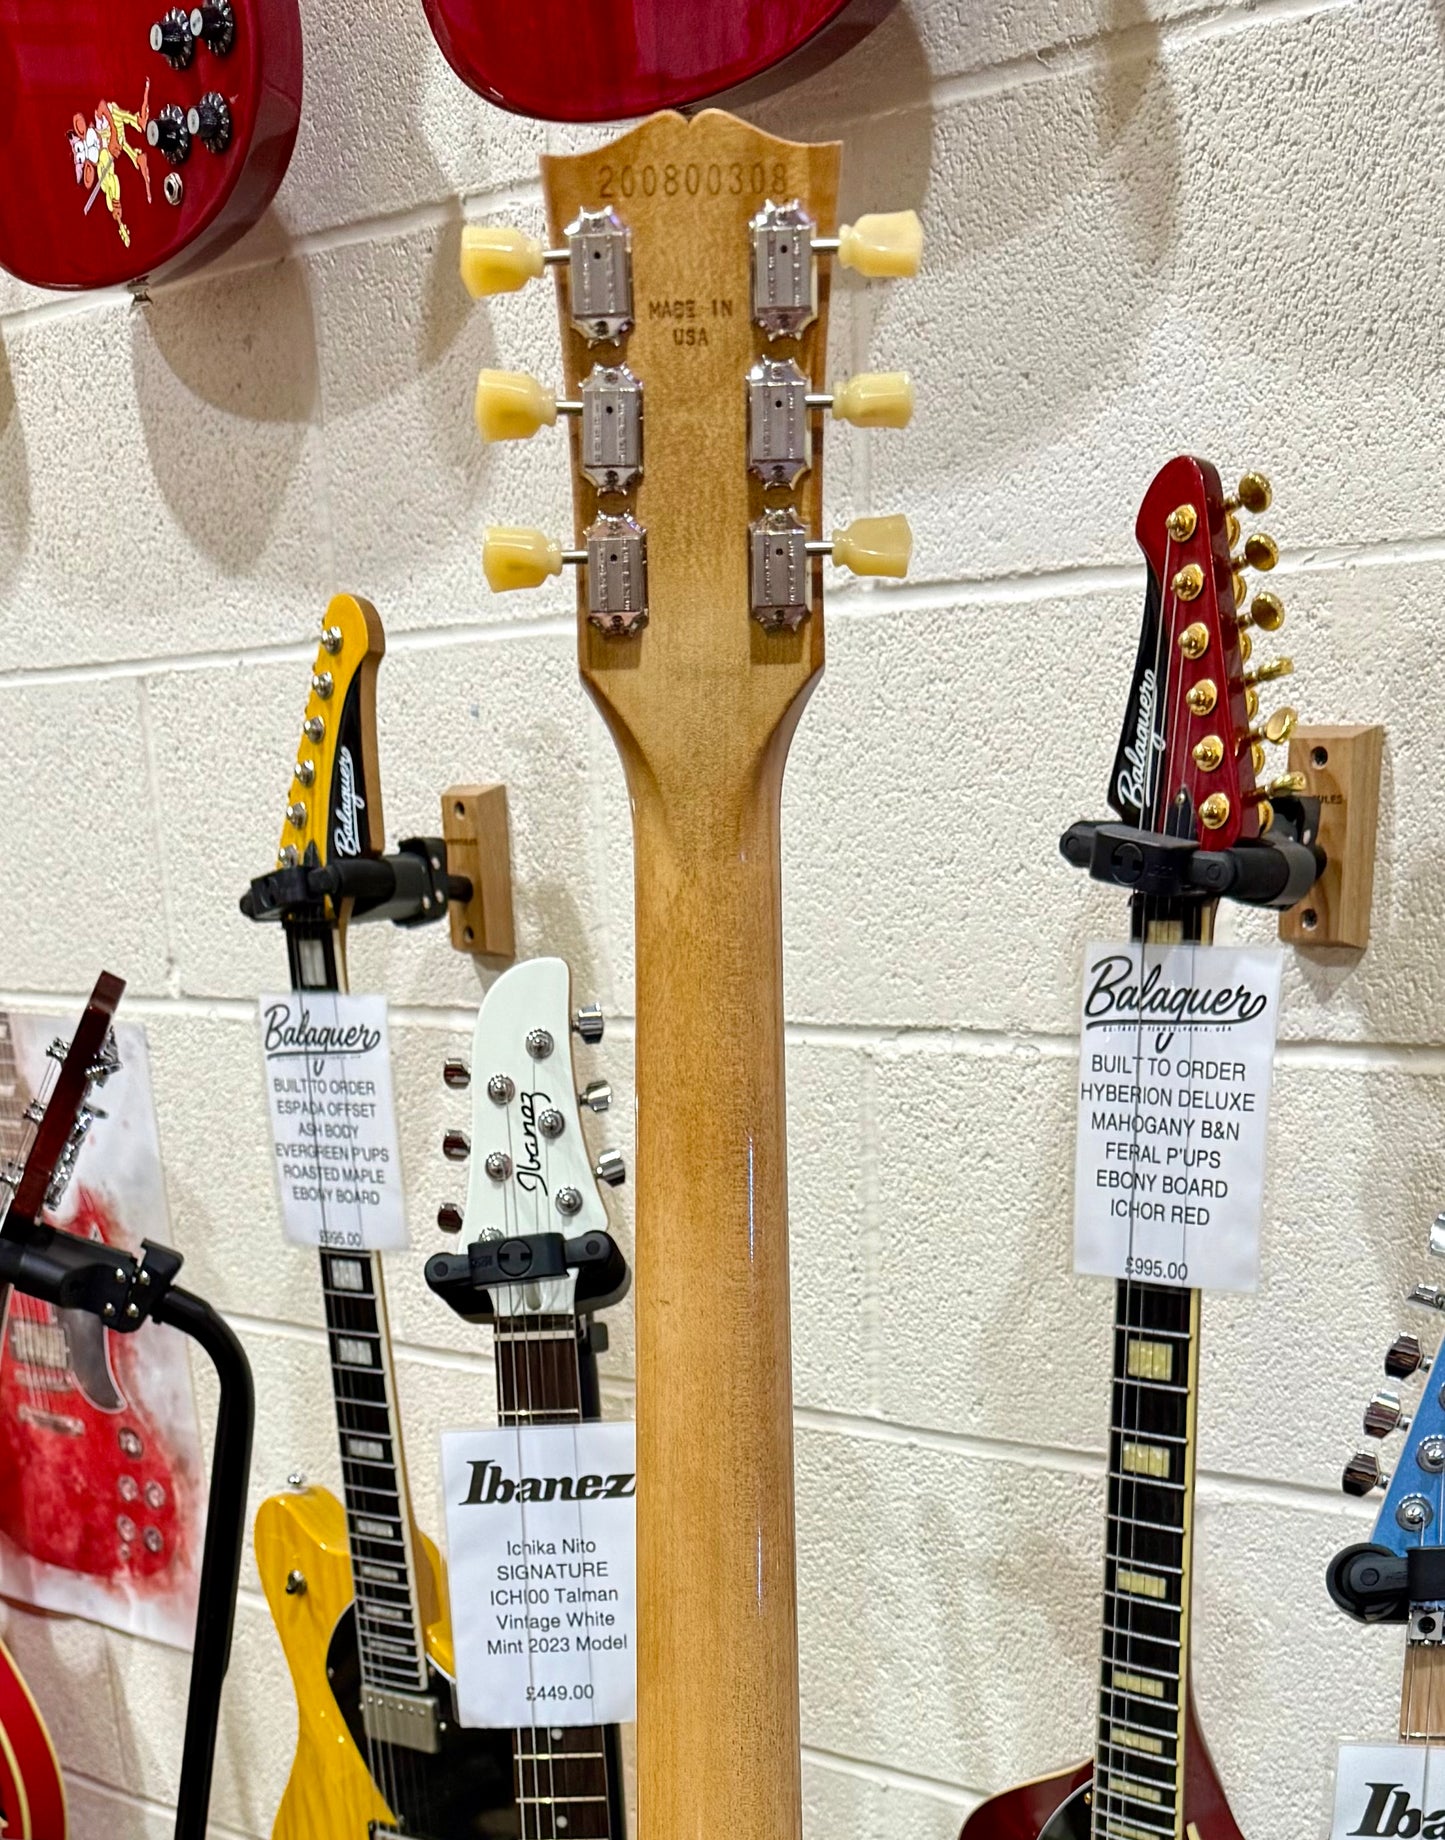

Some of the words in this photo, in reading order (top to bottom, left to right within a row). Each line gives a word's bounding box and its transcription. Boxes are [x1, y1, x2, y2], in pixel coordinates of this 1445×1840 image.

[600, 163, 788, 198] 200800308
[649, 299, 696, 319] MADE
[712, 300, 733, 317] IN
[673, 327, 709, 346] USA
[1117, 669, 1166, 810] Balaguer
[334, 746, 365, 858] Balaguer
[1084, 955, 1267, 1054] Balaguer
[264, 1003, 381, 1077] Balaguer
[1091, 1054, 1144, 1074] BUILT
[1148, 1057, 1171, 1077] TO
[1176, 1060, 1246, 1082] ORDER
[273, 1078, 308, 1094] BUILT
[310, 1079, 328, 1094] TO
[329, 1080, 376, 1096] ORDER
[1080, 1082, 1173, 1107] HYBERION
[1178, 1089, 1256, 1112] DELUXE
[277, 1100, 326, 1116] ESPADA
[327, 1102, 377, 1118] OFFSET
[298, 1122, 323, 1137] ASH
[325, 1123, 359, 1139] BODY
[1091, 1112, 1195, 1138] MAHOGANY
[1201, 1120, 1240, 1141] B&N
[275, 1143, 349, 1160] EVERGREEN
[516, 1092, 552, 1197] Ibanez
[1105, 1142, 1161, 1164] FERAL
[1166, 1147, 1221, 1169] P'UPS
[283, 1164, 340, 1181] ROASTED
[342, 1168, 386, 1184] MAPLE
[1096, 1169, 1157, 1192] EBONY
[1162, 1175, 1229, 1199] BOARD
[292, 1186, 333, 1202] EBONY
[336, 1189, 381, 1206] BOARD
[1110, 1198, 1165, 1222] ICHOR
[1171, 1205, 1210, 1226] RED
[1125, 1256, 1188, 1281] £995.00
[458, 1460, 636, 1505] Ibanez
[507, 1540, 556, 1556] Ichika
[563, 1538, 596, 1554] Nito
[497, 1561, 609, 1581] SIGNATURE
[554, 1588, 619, 1603] Talman
[496, 1614, 561, 1632] Vintage
[566, 1611, 615, 1628] White
[487, 1639, 523, 1655] Mint
[529, 1637, 570, 1654] 2023
[576, 1634, 628, 1652] Model
[526, 1684, 594, 1702] £449.00
